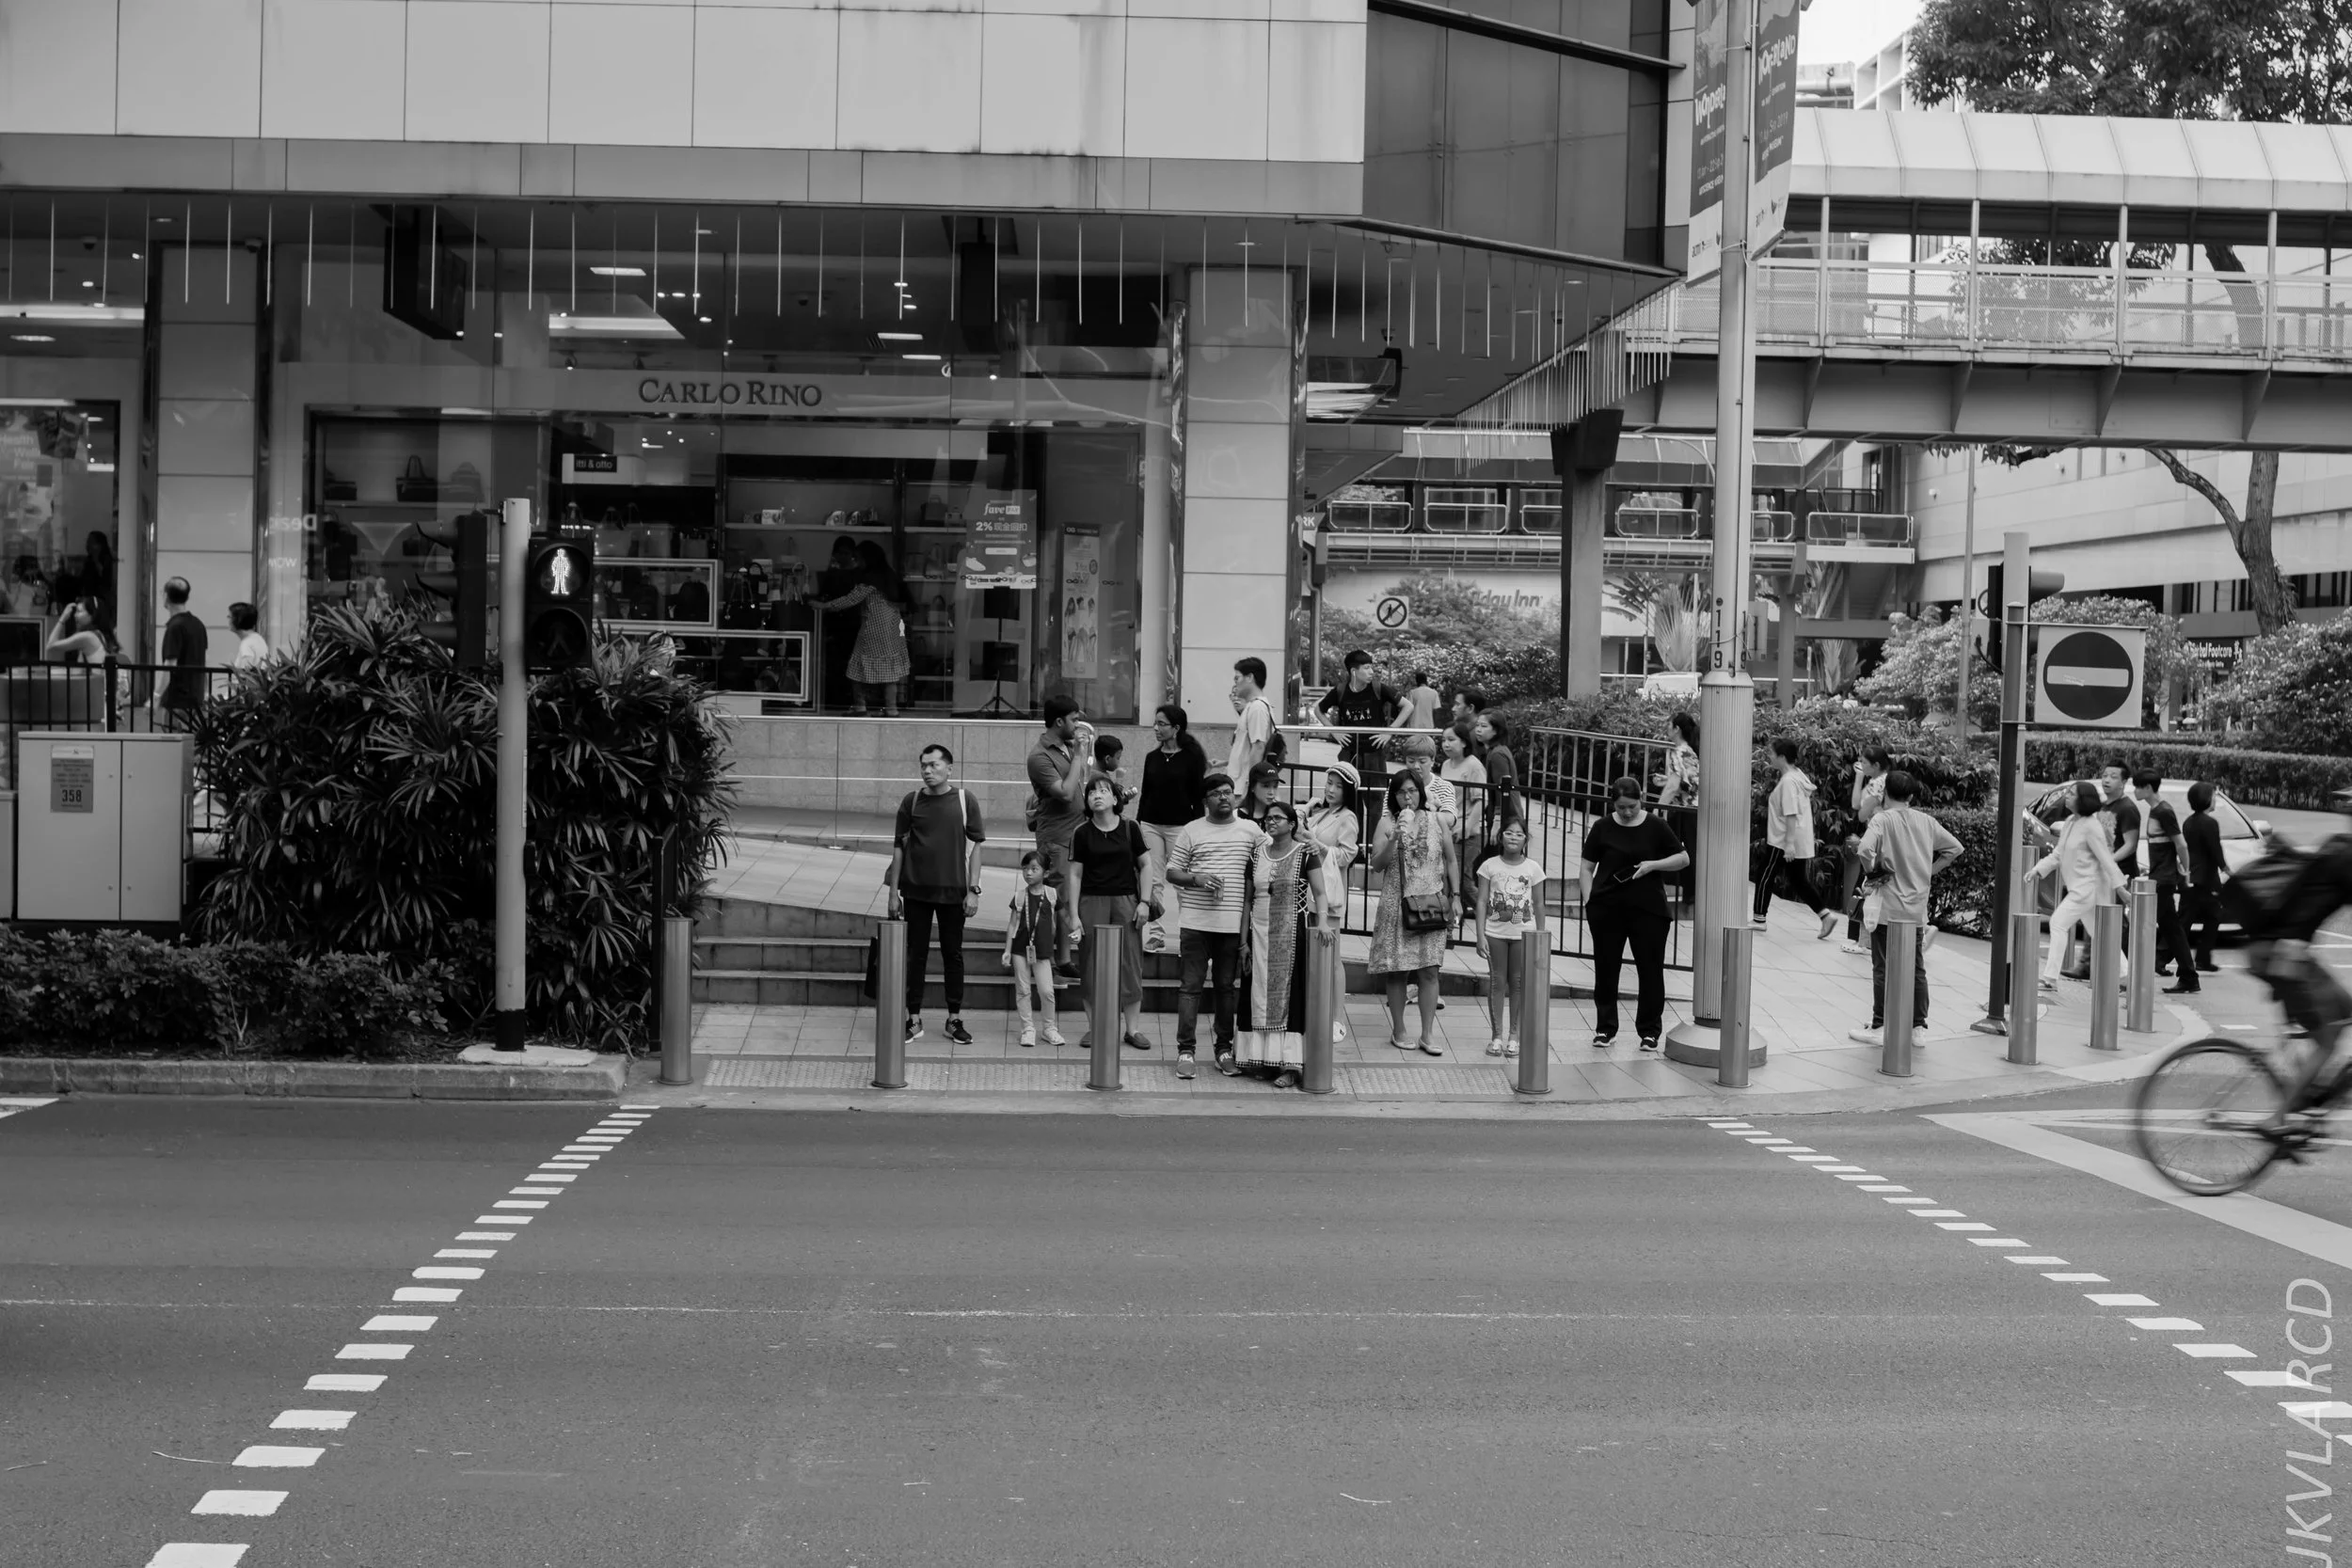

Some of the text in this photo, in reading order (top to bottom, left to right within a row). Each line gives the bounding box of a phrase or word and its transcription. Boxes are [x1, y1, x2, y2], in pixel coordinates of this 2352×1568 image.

[639, 379, 822, 406] CARLO RINO
[976, 521, 993, 531] 2%
[62, 789, 82, 802] 358
